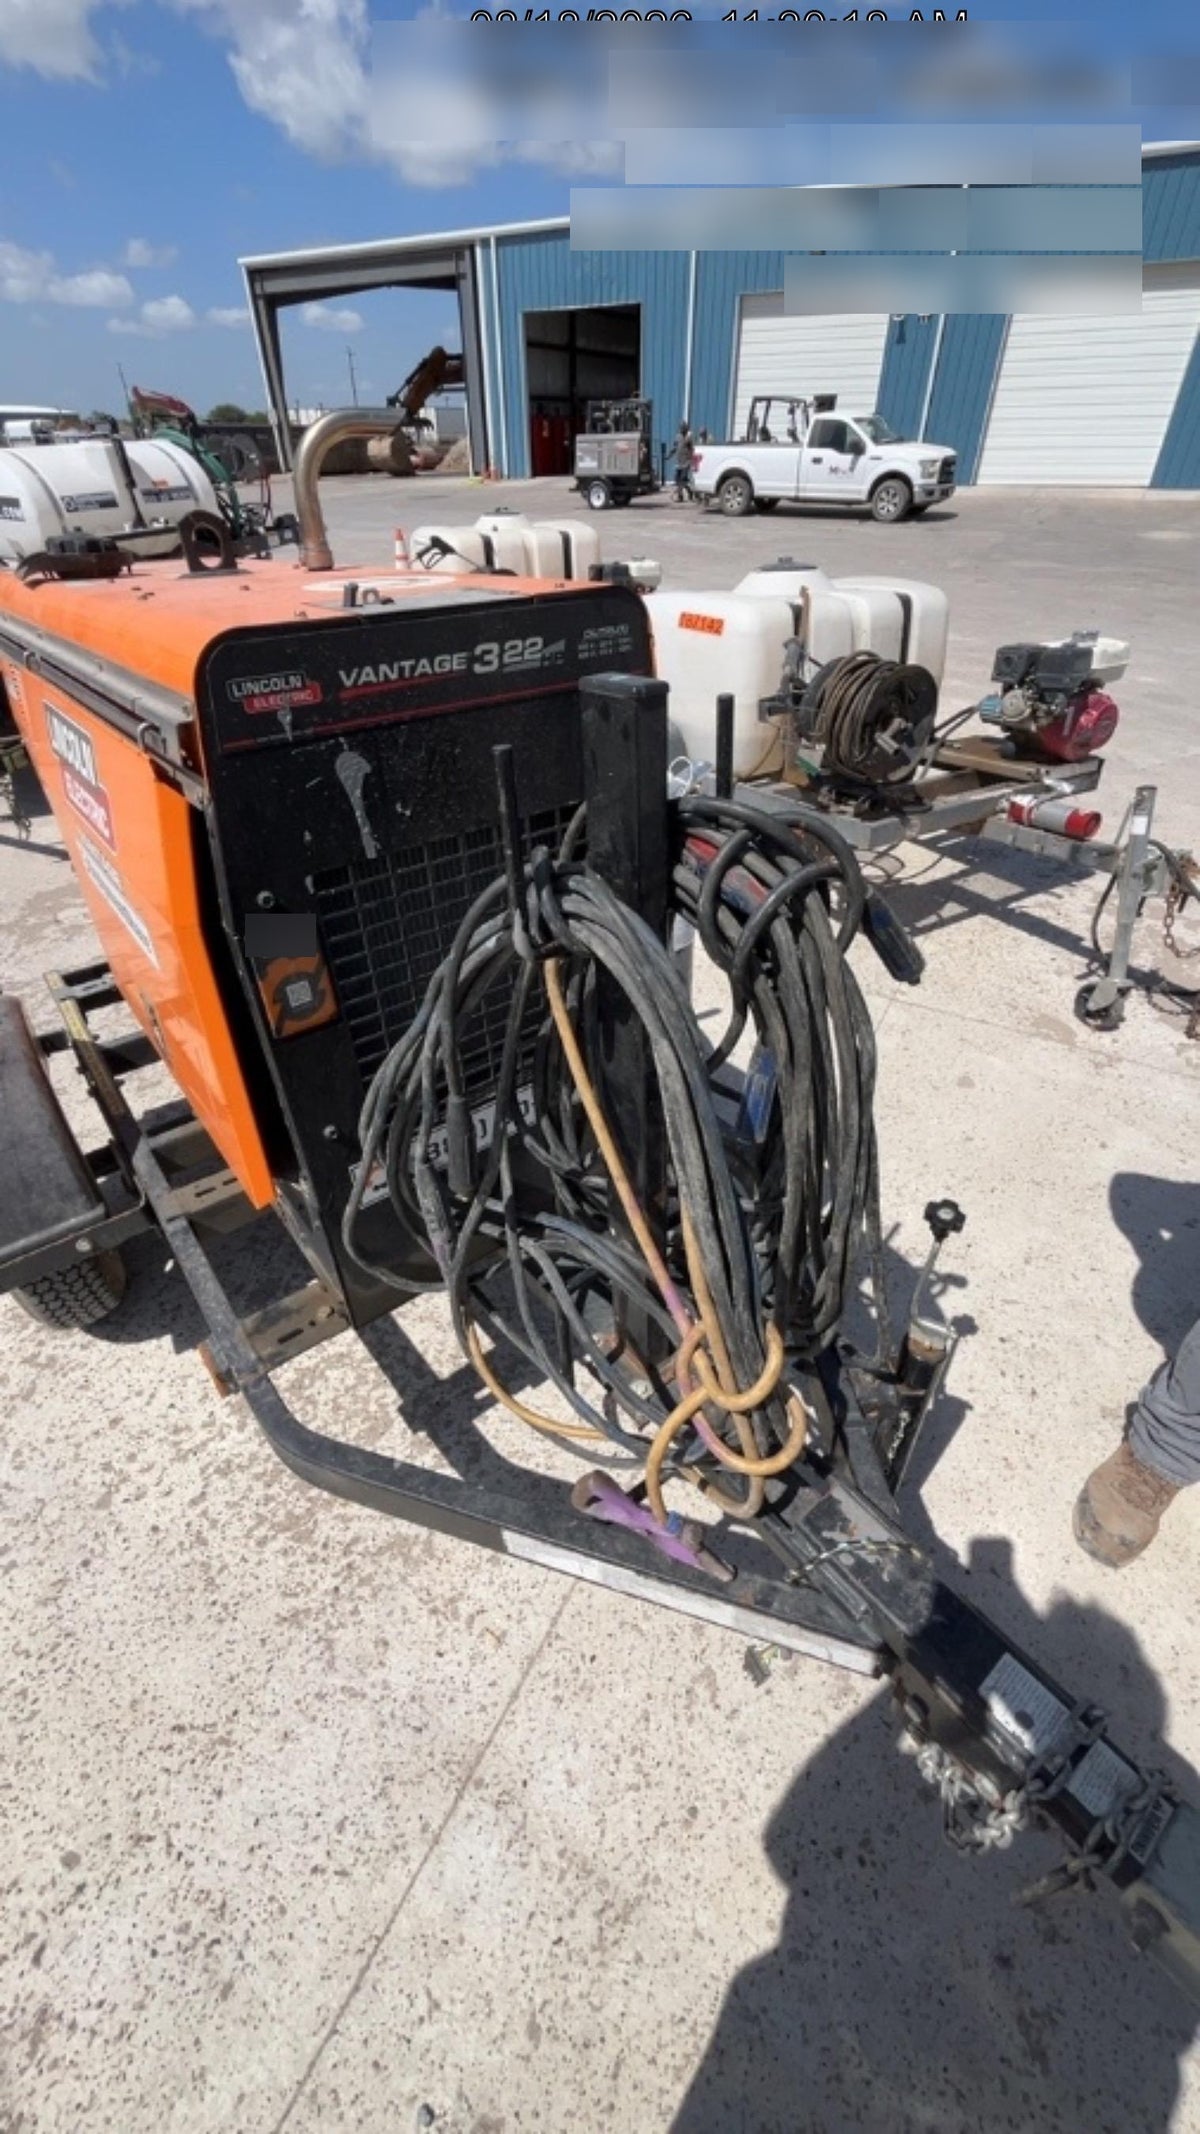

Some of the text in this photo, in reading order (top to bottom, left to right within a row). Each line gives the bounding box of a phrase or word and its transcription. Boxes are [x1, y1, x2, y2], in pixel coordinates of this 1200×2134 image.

[231, 673, 304, 698] LINCOLN
[338, 651, 468, 688] VANTAGE
[473, 637, 544, 675] 322
[252, 689, 314, 709] ELECTRIC
[51, 713, 97, 786] LINCOLN
[63, 771, 111, 841] ELECTRIC
